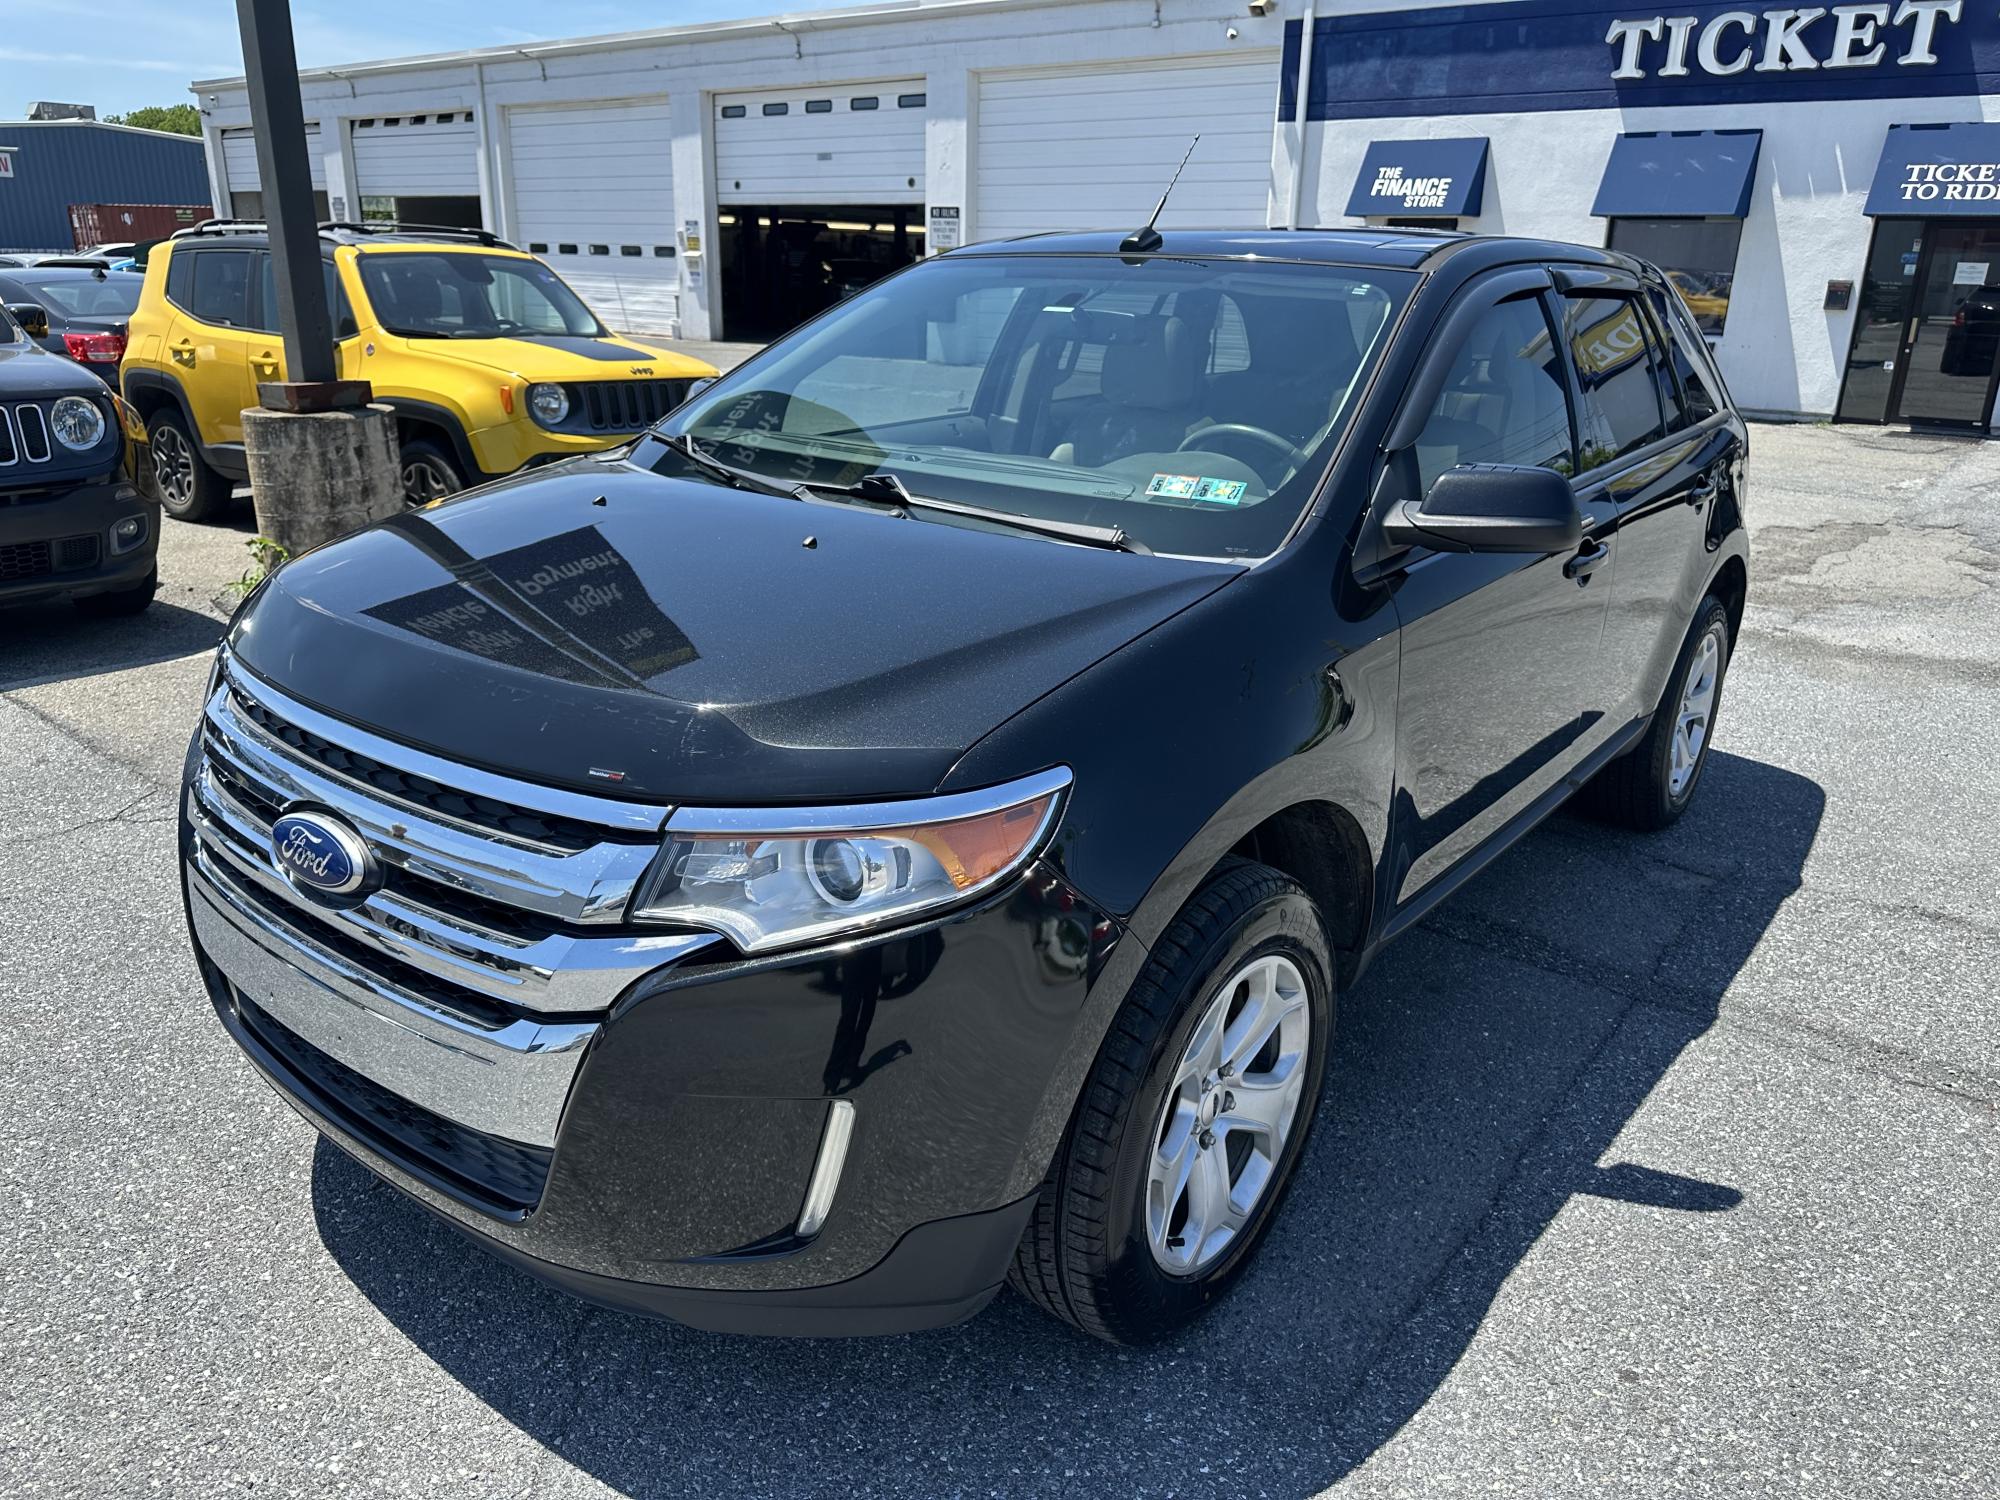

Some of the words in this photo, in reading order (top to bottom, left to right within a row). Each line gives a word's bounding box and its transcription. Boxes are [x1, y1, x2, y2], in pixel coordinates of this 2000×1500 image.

[1605, 0, 1965, 79] TICKET
[1378, 167, 1403, 179] THE
[1906, 164, 2000, 182] TICKE
[1370, 178, 1452, 196] FINANCE
[1900, 183, 1939, 200] TO
[1403, 195, 1446, 208] STORE
[282, 825, 332, 877] Ford
